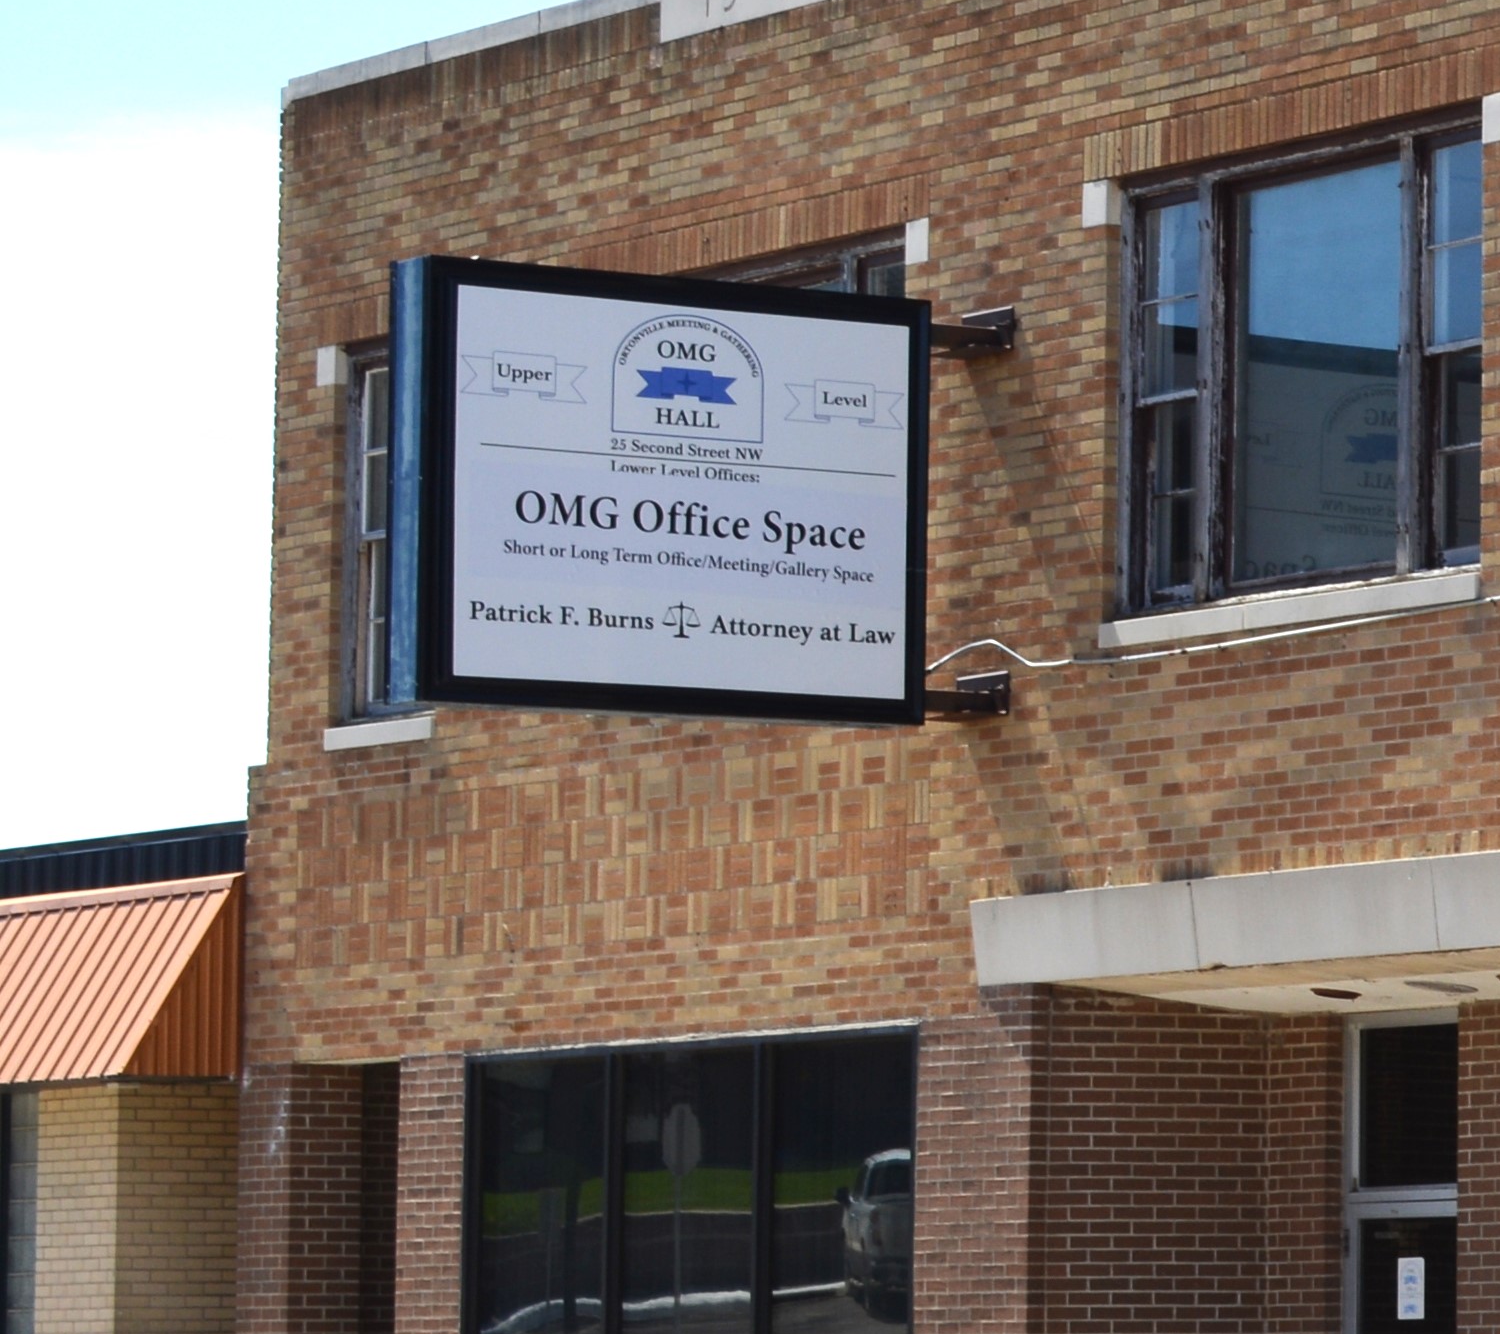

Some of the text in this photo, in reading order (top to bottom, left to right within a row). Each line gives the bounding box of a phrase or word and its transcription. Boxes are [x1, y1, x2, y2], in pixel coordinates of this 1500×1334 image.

[618, 319, 759, 378] ORTONVILLE MEETING & GATHERING
[657, 339, 717, 363] OMG
[496, 362, 553, 385] Upper
[822, 390, 868, 409] Level
[655, 407, 720, 429] HALL
[611, 438, 763, 461] 25 Second Street NW
[611, 459, 760, 483] Lower Level Offices:
[515, 490, 866, 555] OMG Office Space
[503, 539, 874, 584] Short or Long Term Office/Meeting/Gallery Space
[470, 601, 896, 646] Patrick F. Burns Attorney at Law
